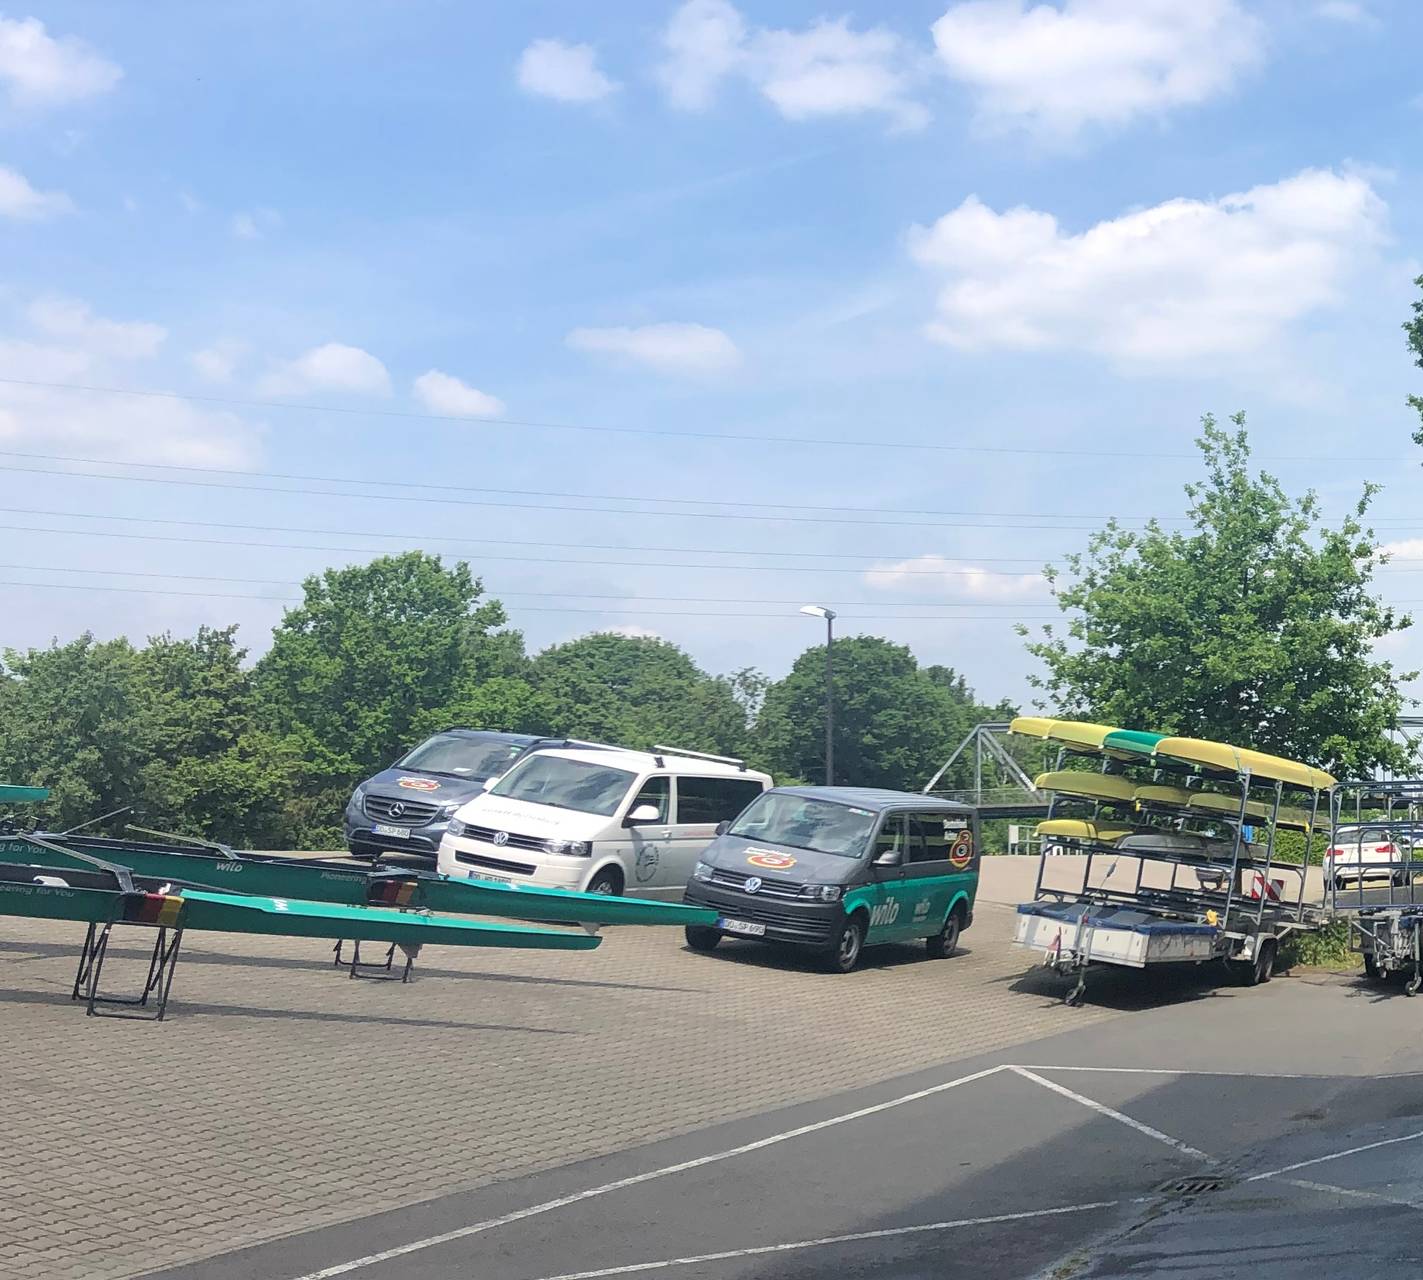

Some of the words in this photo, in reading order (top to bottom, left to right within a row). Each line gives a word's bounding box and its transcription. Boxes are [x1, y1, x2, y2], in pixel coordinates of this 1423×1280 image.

[27, 844, 47, 855] You
[216, 861, 243, 873] wilo
[869, 896, 900, 927] wilo
